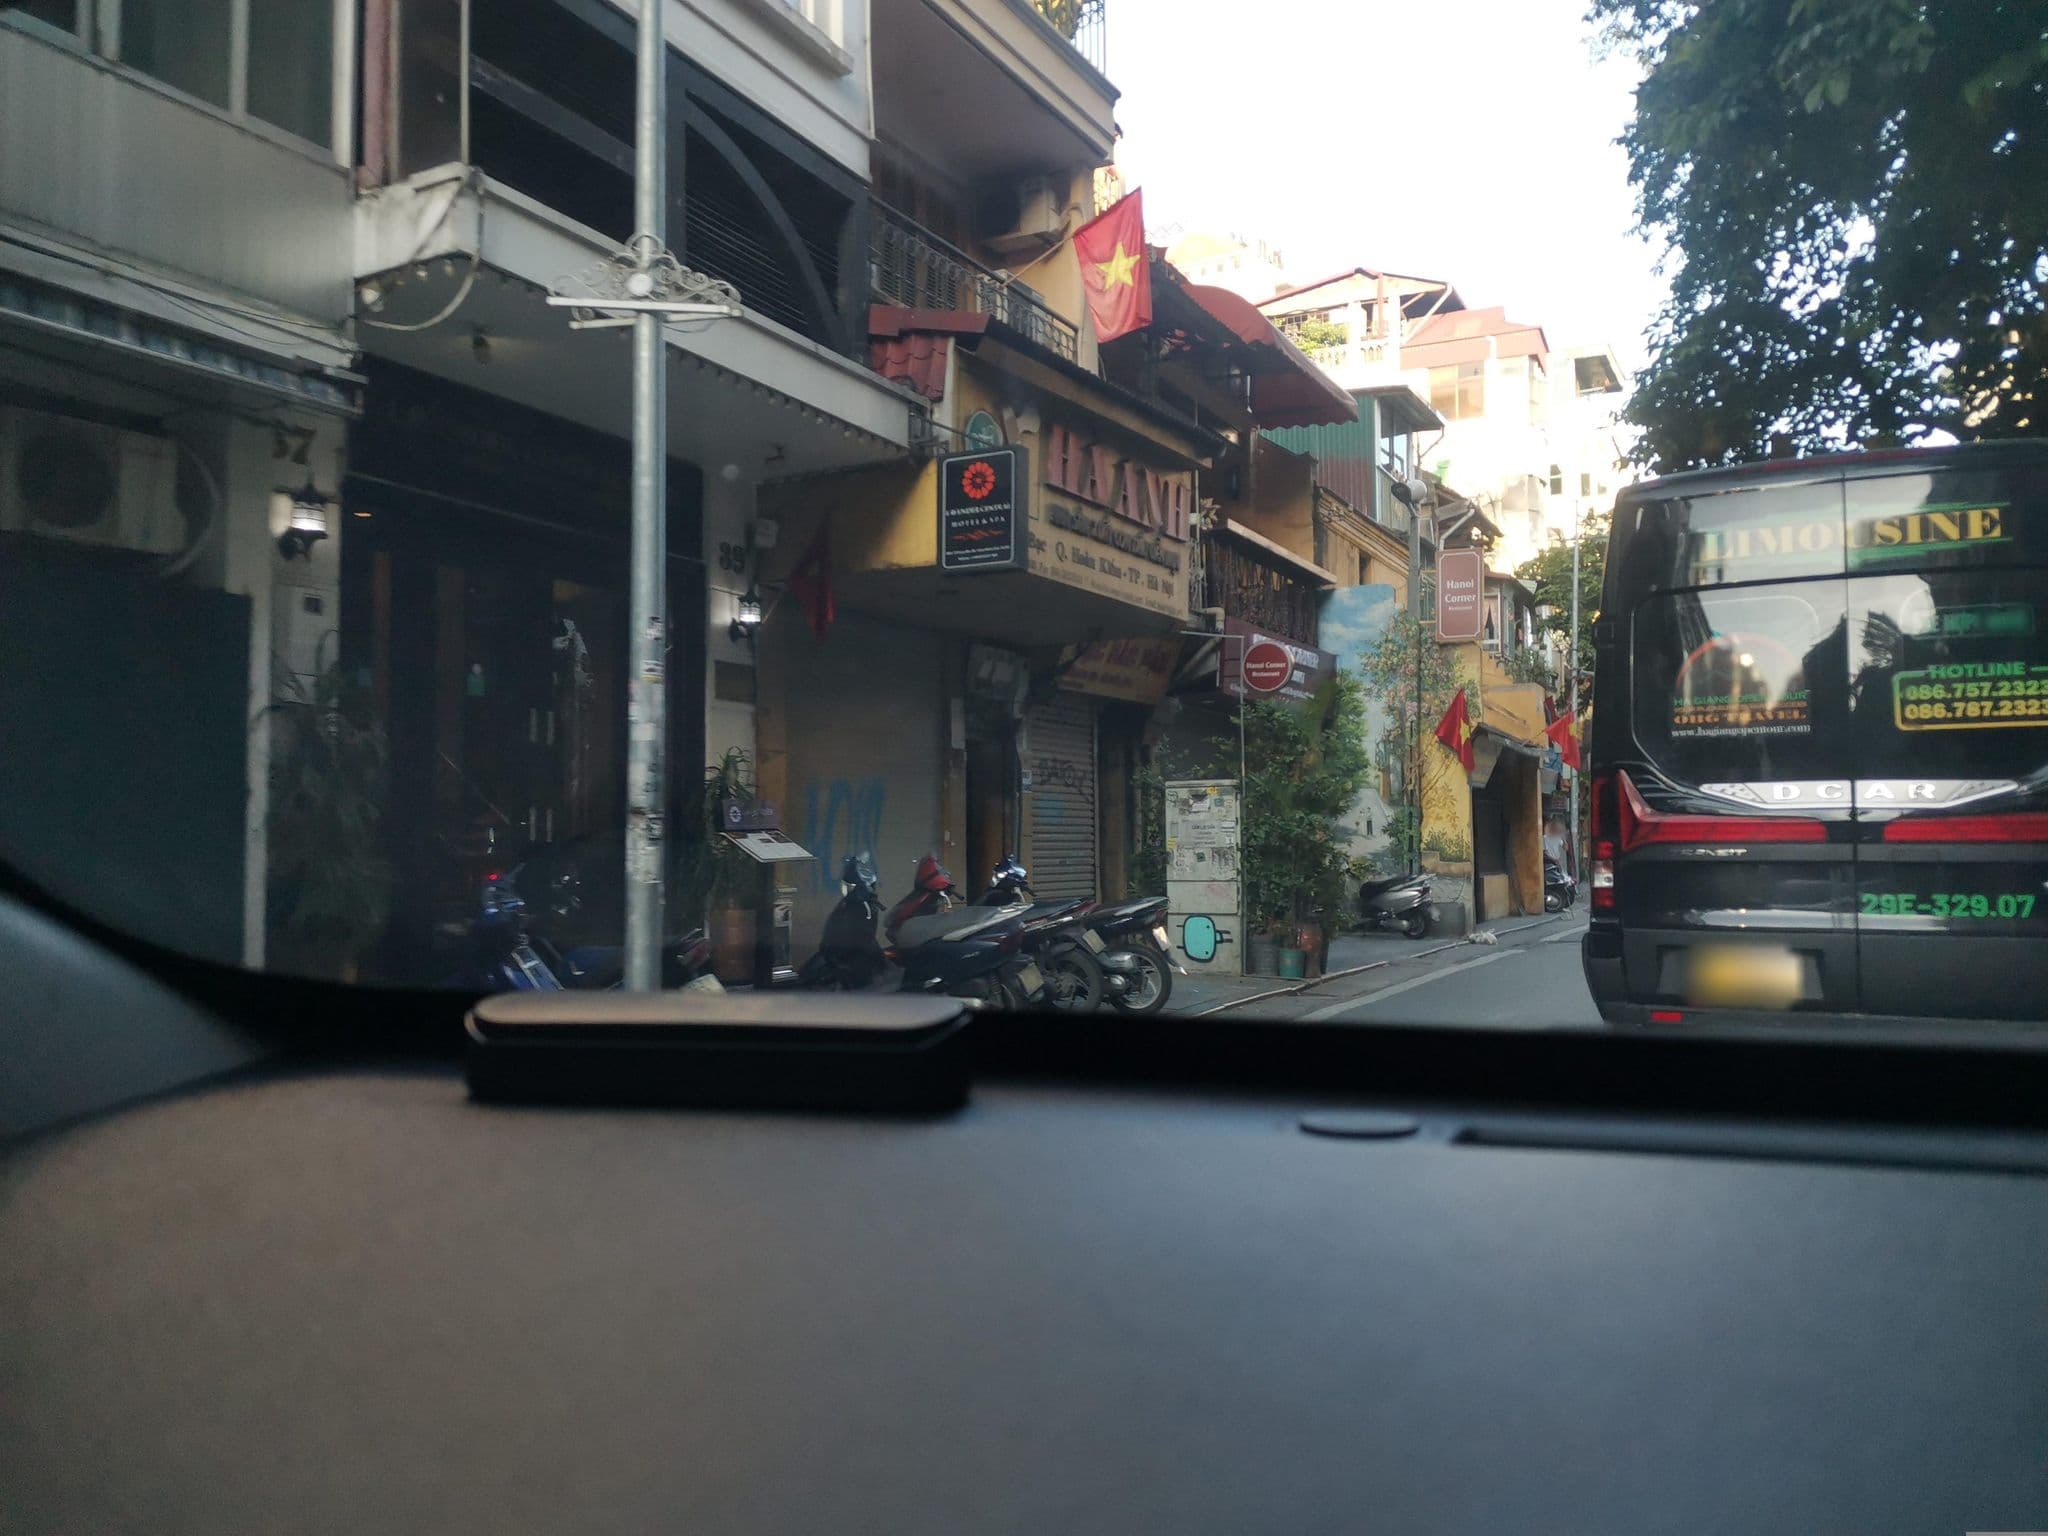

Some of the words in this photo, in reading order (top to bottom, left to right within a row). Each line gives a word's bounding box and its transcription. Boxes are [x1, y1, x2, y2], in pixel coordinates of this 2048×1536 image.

[1701, 507, 2001, 561] LIMOUSINE
[1447, 578, 1474, 589] Hanoi
[1445, 593, 1477, 603] Corner
[1928, 661, 2026, 679] HOTLINE
[1861, 893, 2036, 918] 29E-329.07
